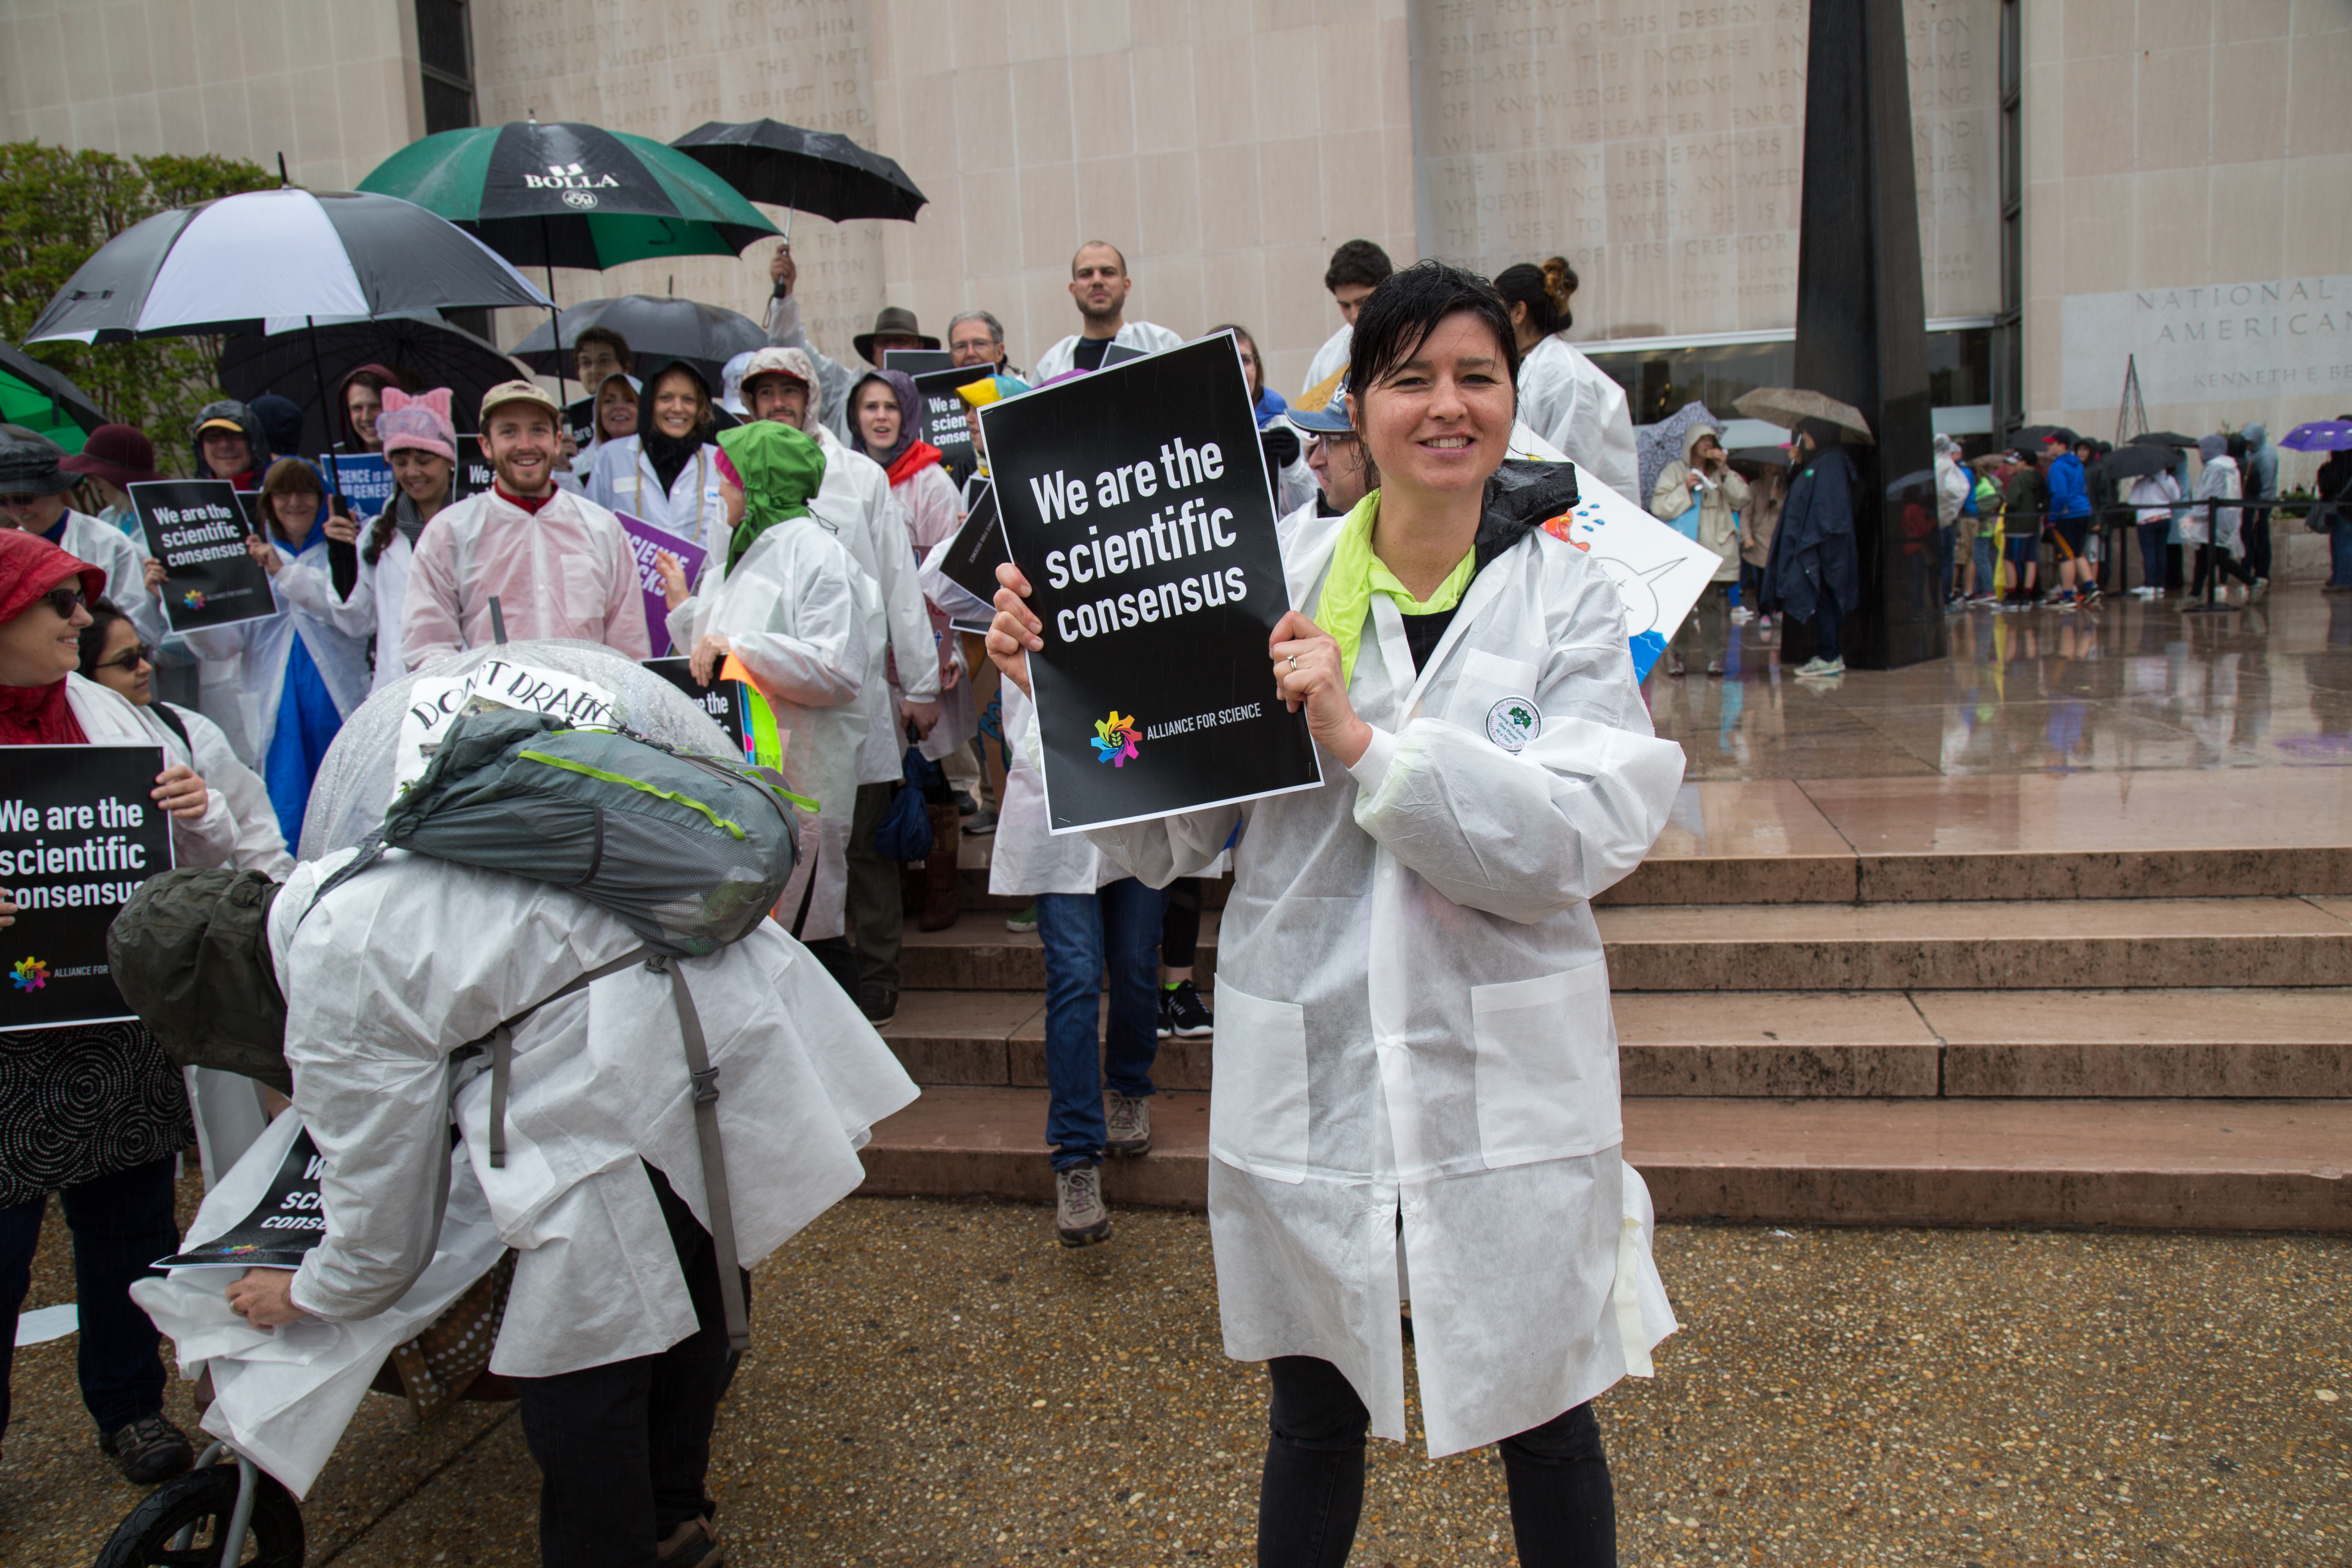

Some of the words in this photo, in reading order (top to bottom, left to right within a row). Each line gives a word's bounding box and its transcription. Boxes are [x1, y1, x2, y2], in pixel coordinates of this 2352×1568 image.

[1436, 1, 1476, 22] THE
[603, 41, 690, 67] WITHOUT
[773, 26, 797, 43] TO
[815, 17, 854, 37] HIM
[1439, 26, 1558, 55] SIMPLICITY
[1623, 14, 1657, 34] HIS
[1678, 3, 1757, 28] DESIGN
[756, 58, 791, 77] THE
[1439, 61, 1547, 87] DECLARED
[1580, 52, 1619, 74] THE
[1644, 38, 1749, 66] INCREASE
[688, 98, 722, 116] ARE
[738, 84, 815, 107] SUBJECT
[831, 79, 857, 97] TO
[1442, 101, 1470, 119] OF
[1494, 85, 1629, 115] KNOWLEDGE
[1648, 75, 1732, 99] AMONG
[1521, 126, 1547, 145] BE
[1570, 111, 1705, 141] HEREAFTER
[1443, 164, 1485, 185] THE
[1626, 137, 1782, 167] BENEFACTORS
[523, 174, 620, 189] BOLLA
[1444, 190, 1546, 214] WHOEVER
[1565, 178, 1678, 205] INCREASES
[817, 231, 848, 249] THE
[1446, 225, 1487, 246] THE
[1507, 220, 1556, 240] USES
[1574, 216, 1602, 234] TO
[1619, 208, 1693, 230] WHICH
[1712, 204, 1736, 224] HE
[1757, 202, 1775, 220] IS
[1576, 247, 1605, 266] OF
[1623, 242, 1663, 261] HIS
[1684, 233, 1788, 257] CREATOR
[2135, 279, 2333, 312] NATIONAL
[2193, 368, 2296, 387] KENNETH
[928, 397, 948, 413] We
[469, 465, 489, 484] We
[1029, 470, 1089, 524] We
[1096, 461, 1158, 508] are
[1160, 437, 1224, 489] the
[153, 506, 180, 526] We
[181, 506, 208, 522] are
[206, 503, 233, 519] the
[160, 521, 241, 548] scientific
[1046, 497, 1237, 589] scientific
[167, 542, 247, 567] consensus
[1057, 567, 1247, 642] consensus
[410, 661, 511, 730] DON'T
[706, 691, 729, 714] the
[1147, 717, 1195, 740] ALLIANCE
[1197, 712, 1217, 730] FOR
[1219, 702, 1262, 725] SCIENCE
[1494, 701, 1506, 711] MSC
[1506, 700, 1538, 720] Environmental
[1529, 720, 1539, 741] Sciences
[1497, 712, 1510, 725] Saving
[1516, 729, 1528, 741] Galaxy
[1498, 722, 1507, 731] One
[1507, 729, 1519, 741] Planet
[1495, 738, 1513, 749] Science
[1503, 735, 1513, 744] Time
[0, 799, 40, 832] We
[46, 805, 94, 831] are
[98, 797, 144, 828] the
[0, 836, 146, 876] scientific
[54, 965, 92, 978] ALLIANCE
[93, 964, 109, 975] FOR
